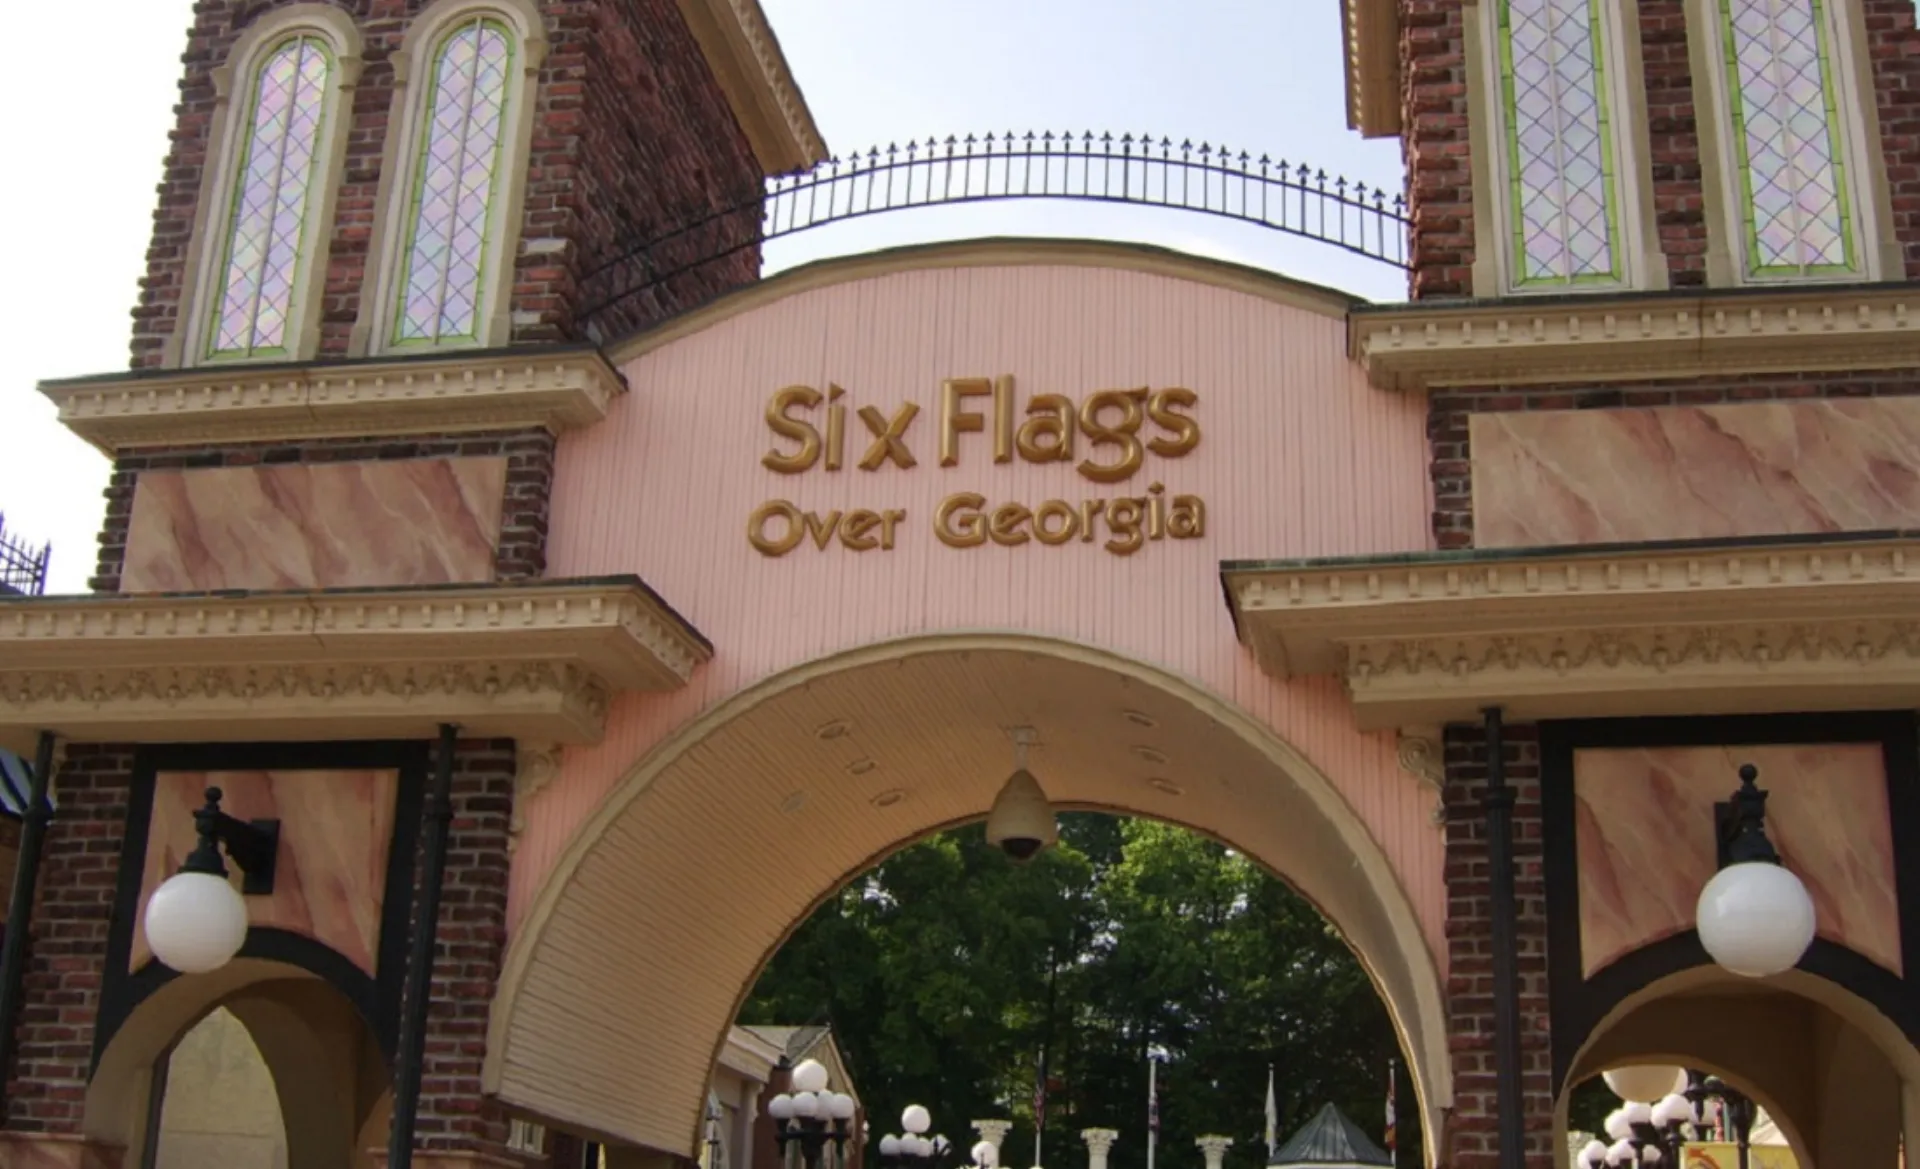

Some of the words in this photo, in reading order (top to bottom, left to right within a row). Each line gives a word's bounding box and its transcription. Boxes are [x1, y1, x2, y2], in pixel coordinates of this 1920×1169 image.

[761, 382, 920, 474] Six
[939, 374, 1201, 483] Flags
[747, 498, 906, 557] Over
[933, 481, 1206, 555] Georgia
